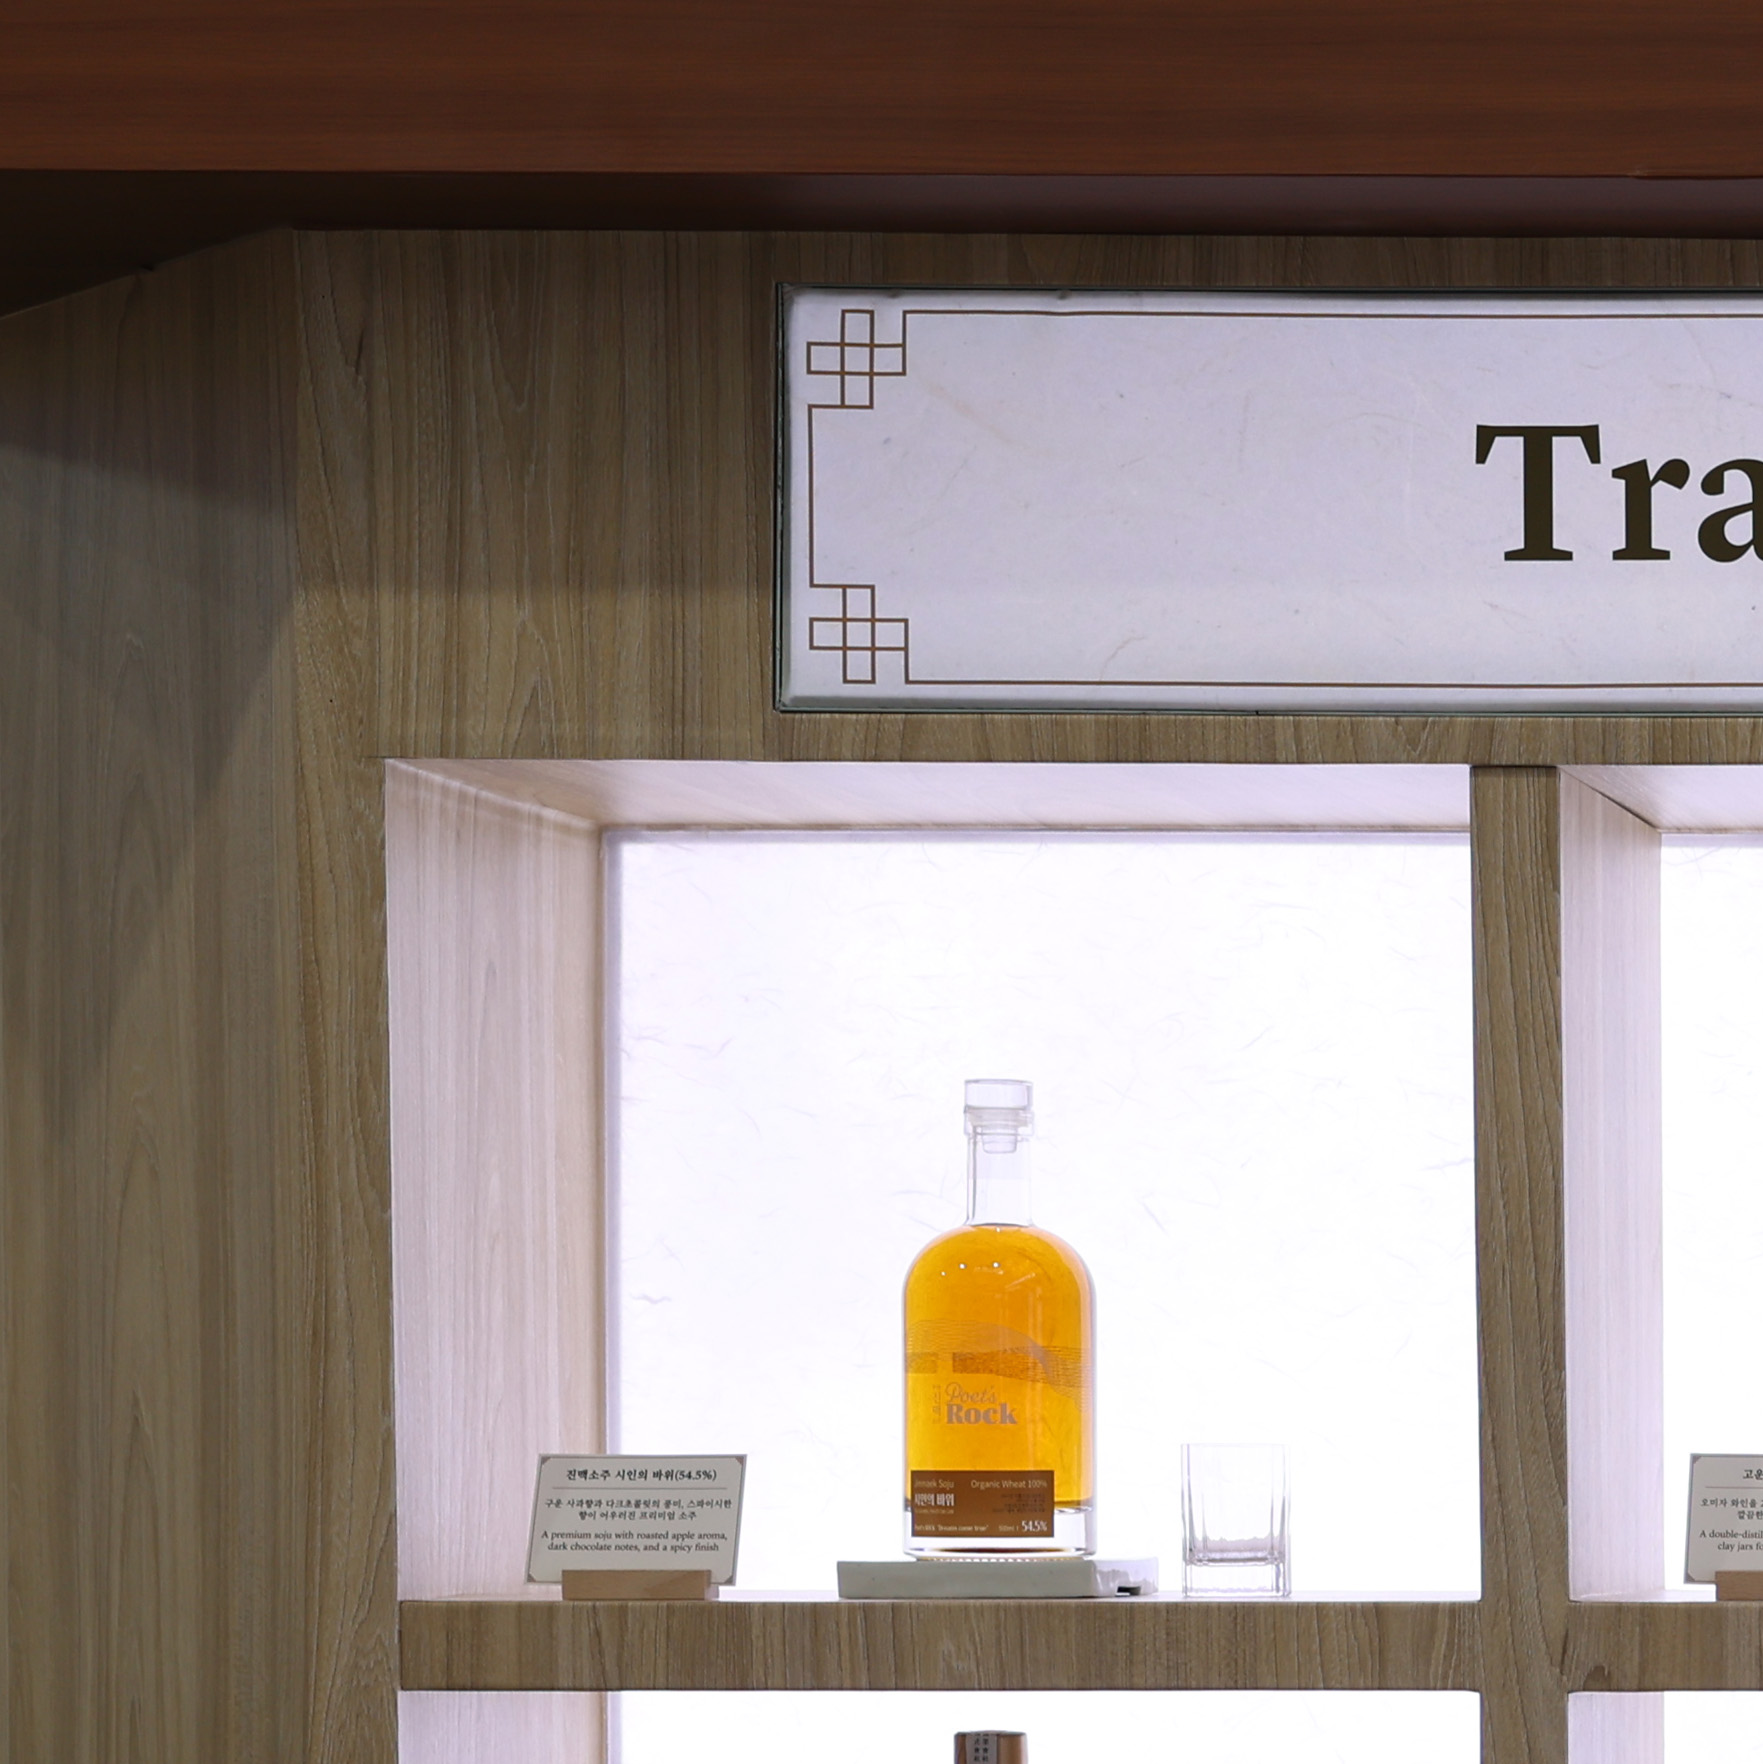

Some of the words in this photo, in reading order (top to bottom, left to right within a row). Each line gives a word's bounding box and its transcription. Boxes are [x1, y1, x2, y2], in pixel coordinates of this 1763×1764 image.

[947, 1403, 1018, 1425] Rock
[566, 1468, 610, 1481] 진맥소주
[615, 1468, 648, 1481] 시인의
[970, 1479, 1000, 1491] Organic
[1002, 1479, 1026, 1489] Wheat
[1028, 1479, 1048, 1489] 100%
[1021, 1520, 1048, 1532] 54.5%
[550, 1530, 591, 1541] premium
[594, 1530, 612, 1541] soju
[614, 1530, 634, 1539] with
[636, 1530, 669, 1539] roasted
[671, 1530, 695, 1542] apple
[697, 1532, 727, 1541] aroma,
